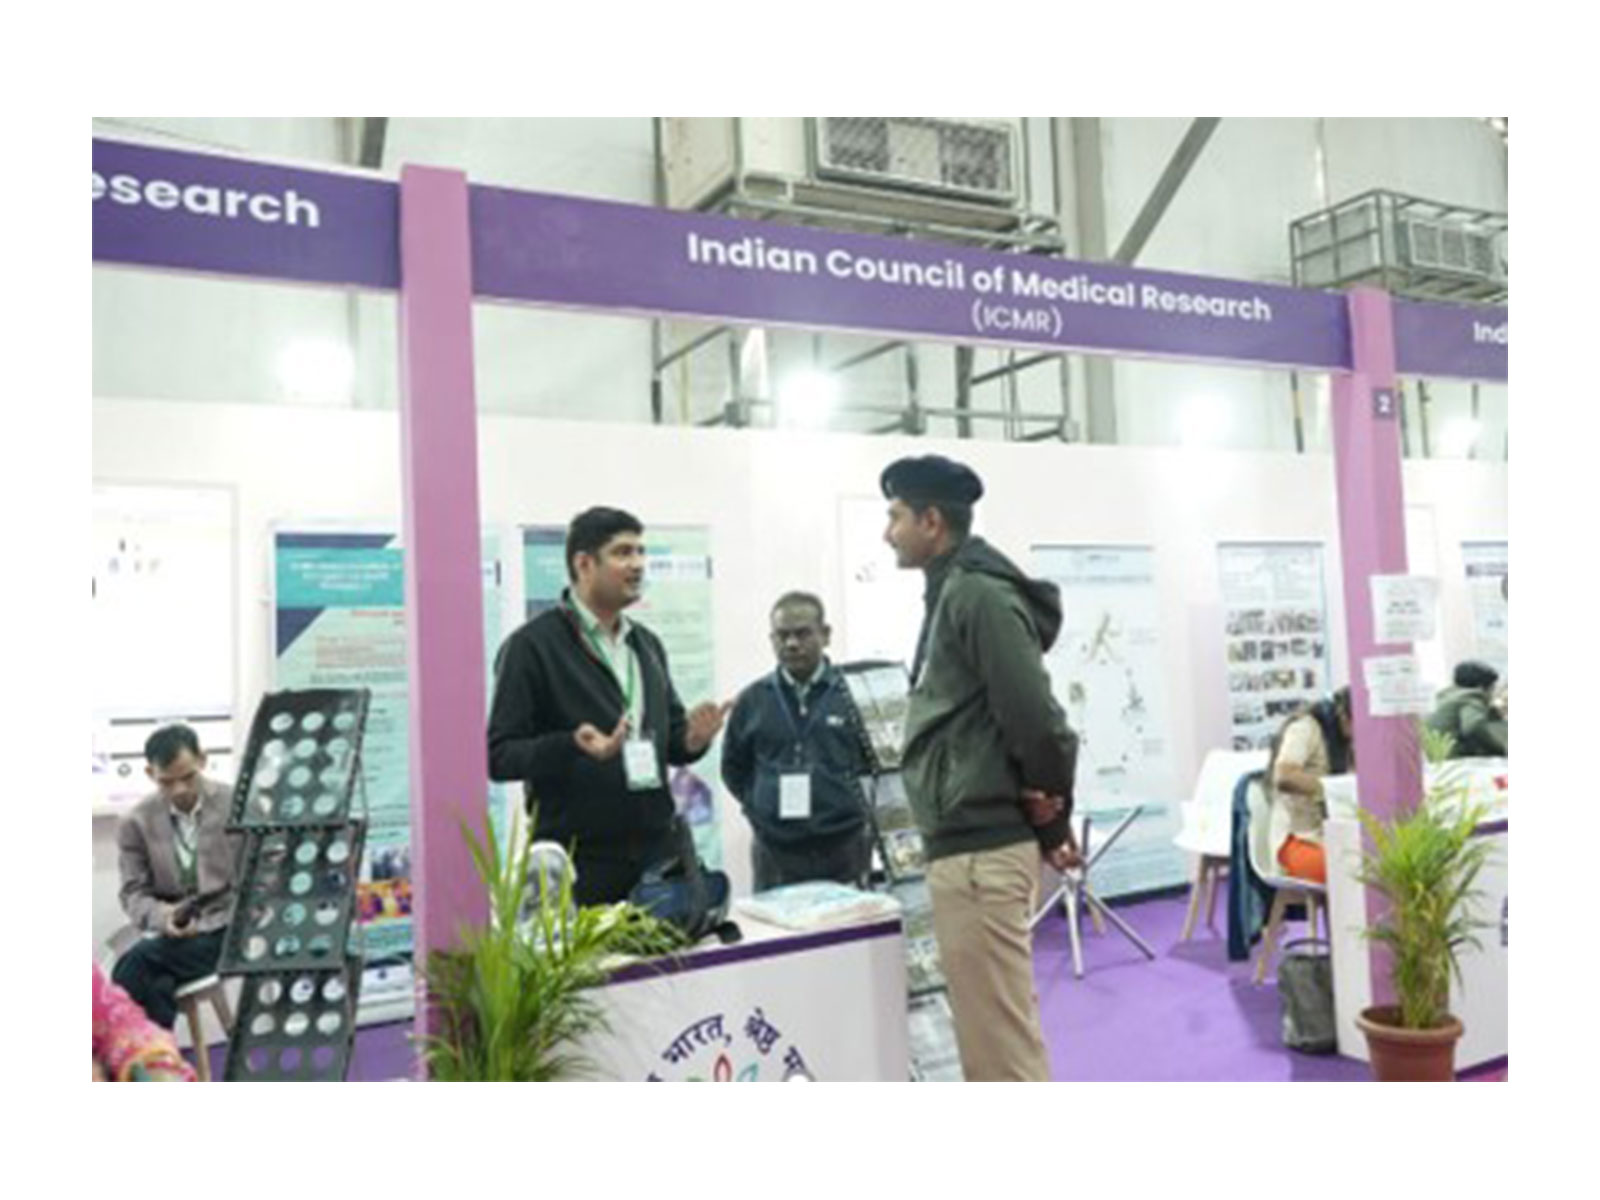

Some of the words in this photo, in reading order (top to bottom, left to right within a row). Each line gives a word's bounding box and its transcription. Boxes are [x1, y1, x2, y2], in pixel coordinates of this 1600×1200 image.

[687, 233, 818, 275] Indian
[825, 249, 965, 290] Council
[971, 266, 1004, 293] of
[1011, 269, 1136, 308] Medical
[1141, 284, 1272, 321] Research
[971, 299, 1063, 338] (ICMR)
